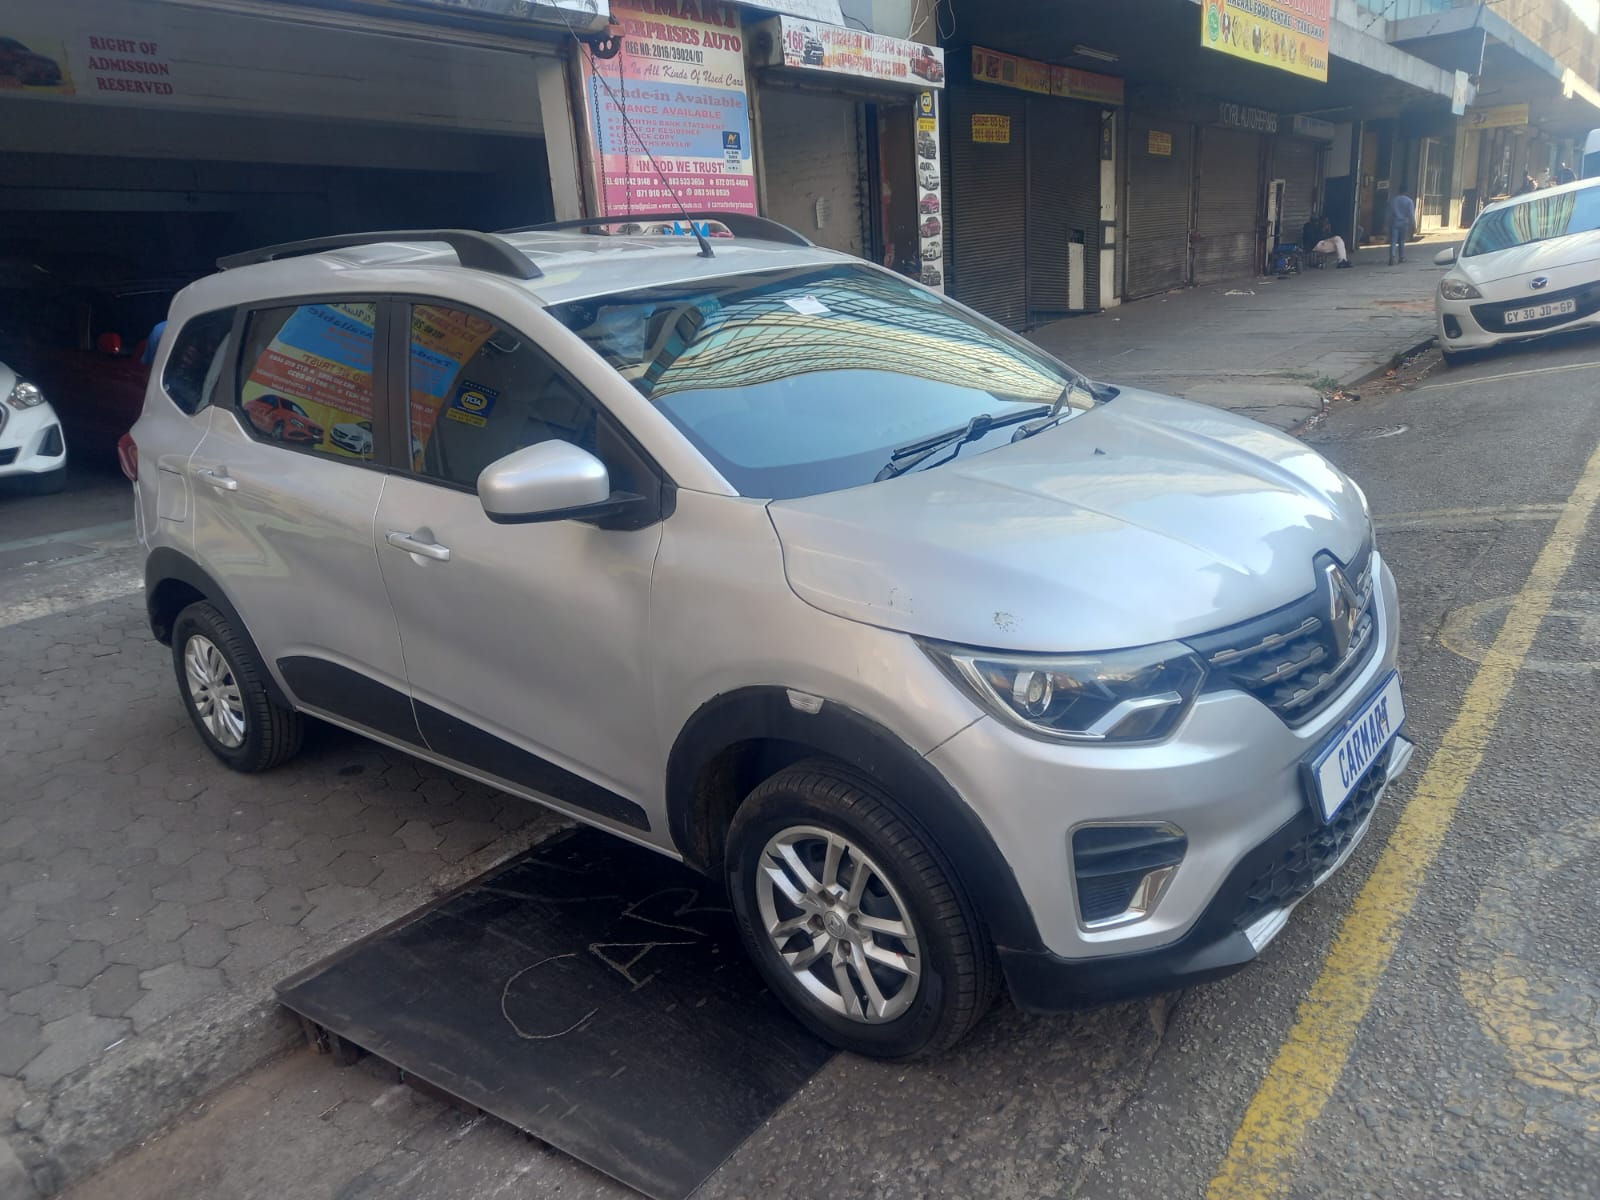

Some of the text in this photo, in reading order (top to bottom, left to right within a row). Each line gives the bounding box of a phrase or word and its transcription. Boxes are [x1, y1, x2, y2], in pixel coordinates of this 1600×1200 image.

[1254, 3, 1270, 20] FOOD
[88, 35, 158, 56] RIGHT OF
[625, 41, 639, 55] REG
[703, 31, 742, 53] AUTO
[88, 56, 170, 76] ADMISSION
[644, 64, 660, 76] All
[662, 65, 688, 80] Kinds
[690, 69, 701, 85] Of
[703, 72, 723, 85] Used
[725, 74, 744, 87] Cars
[96, 76, 174, 95] RESERVED
[675, 91, 743, 109] Available
[662, 106, 722, 119] AVAILABLE
[676, 161, 691, 173] WE
[692, 162, 724, 173] TRUST'
[1507, 301, 1573, 322] CY 30 JD GP
[1338, 696, 1390, 789] CARMART
